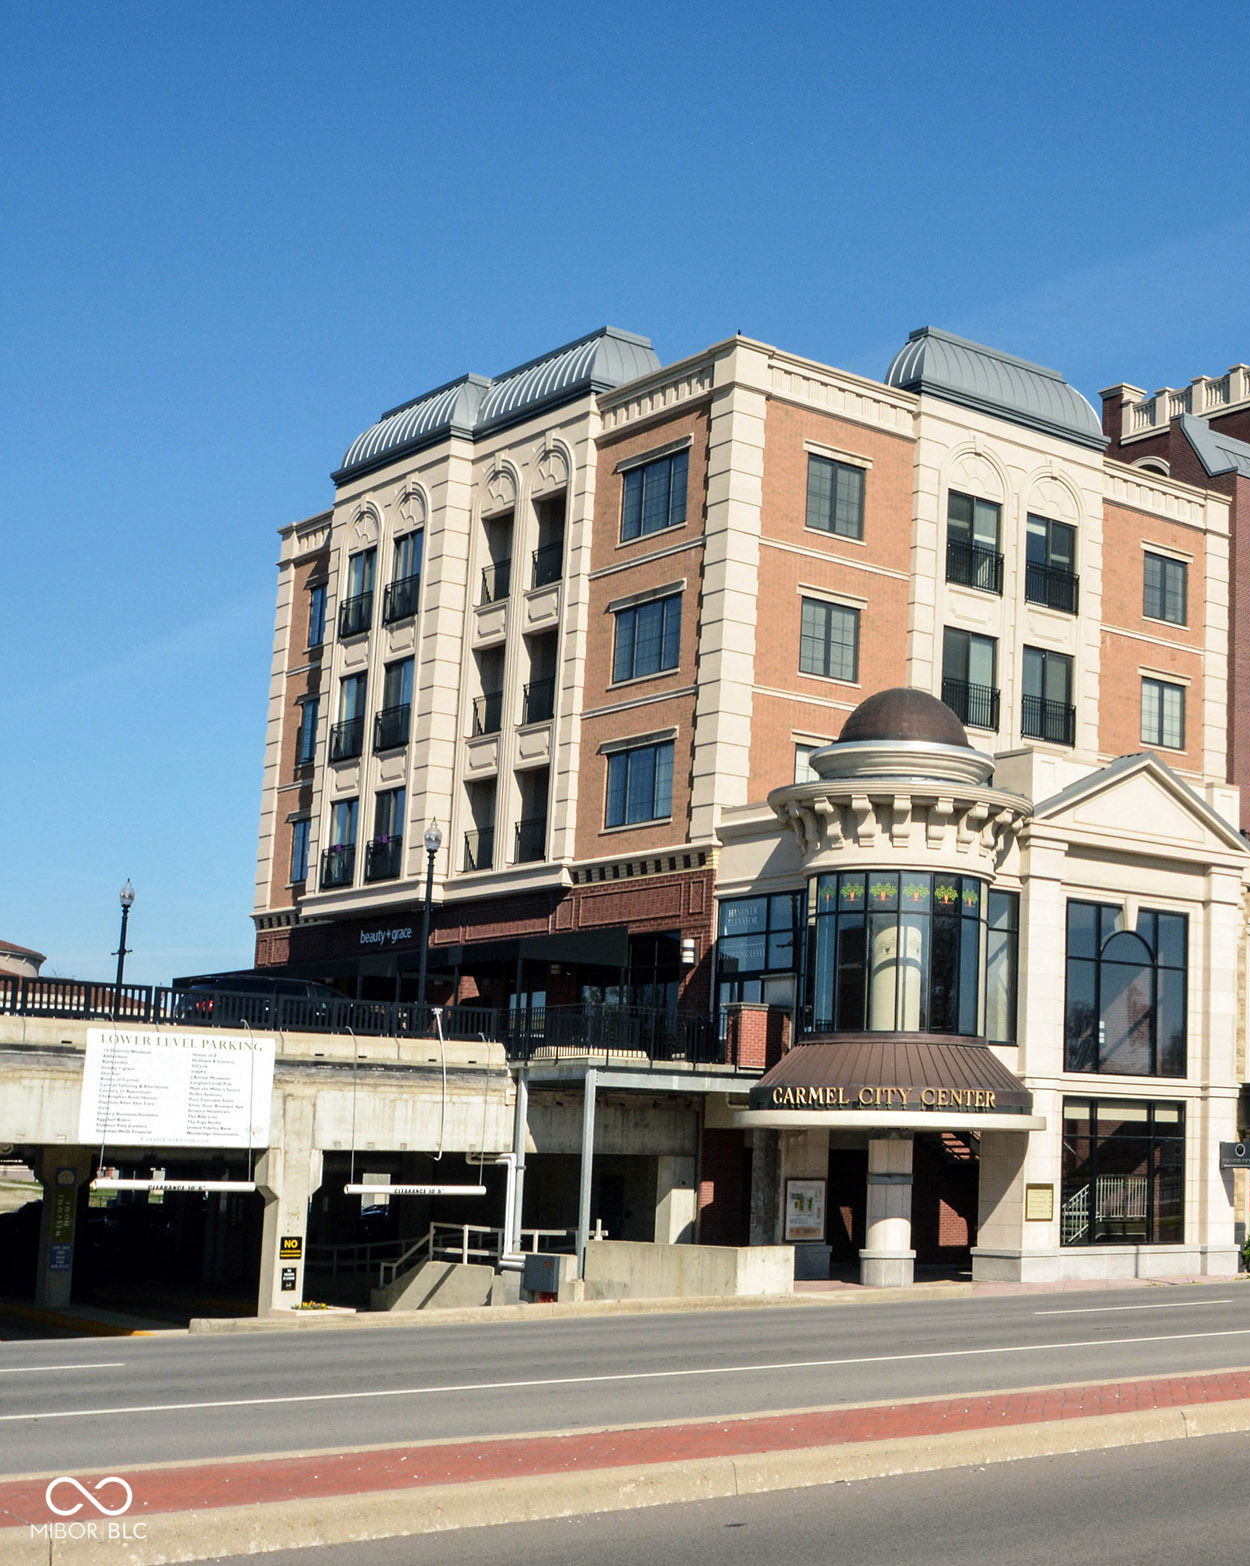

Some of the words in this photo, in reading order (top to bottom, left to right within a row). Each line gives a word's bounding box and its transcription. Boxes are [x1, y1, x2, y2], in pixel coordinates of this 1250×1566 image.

[101, 1033, 151, 1046] LOWER
[157, 1036, 197, 1048] LEVEL
[202, 1039, 263, 1052] PARKING
[773, 1087, 850, 1105] CARMEL
[859, 1087, 912, 1105] CITY
[921, 1088, 996, 1108] CENTER
[284, 1239, 298, 1249] NO
